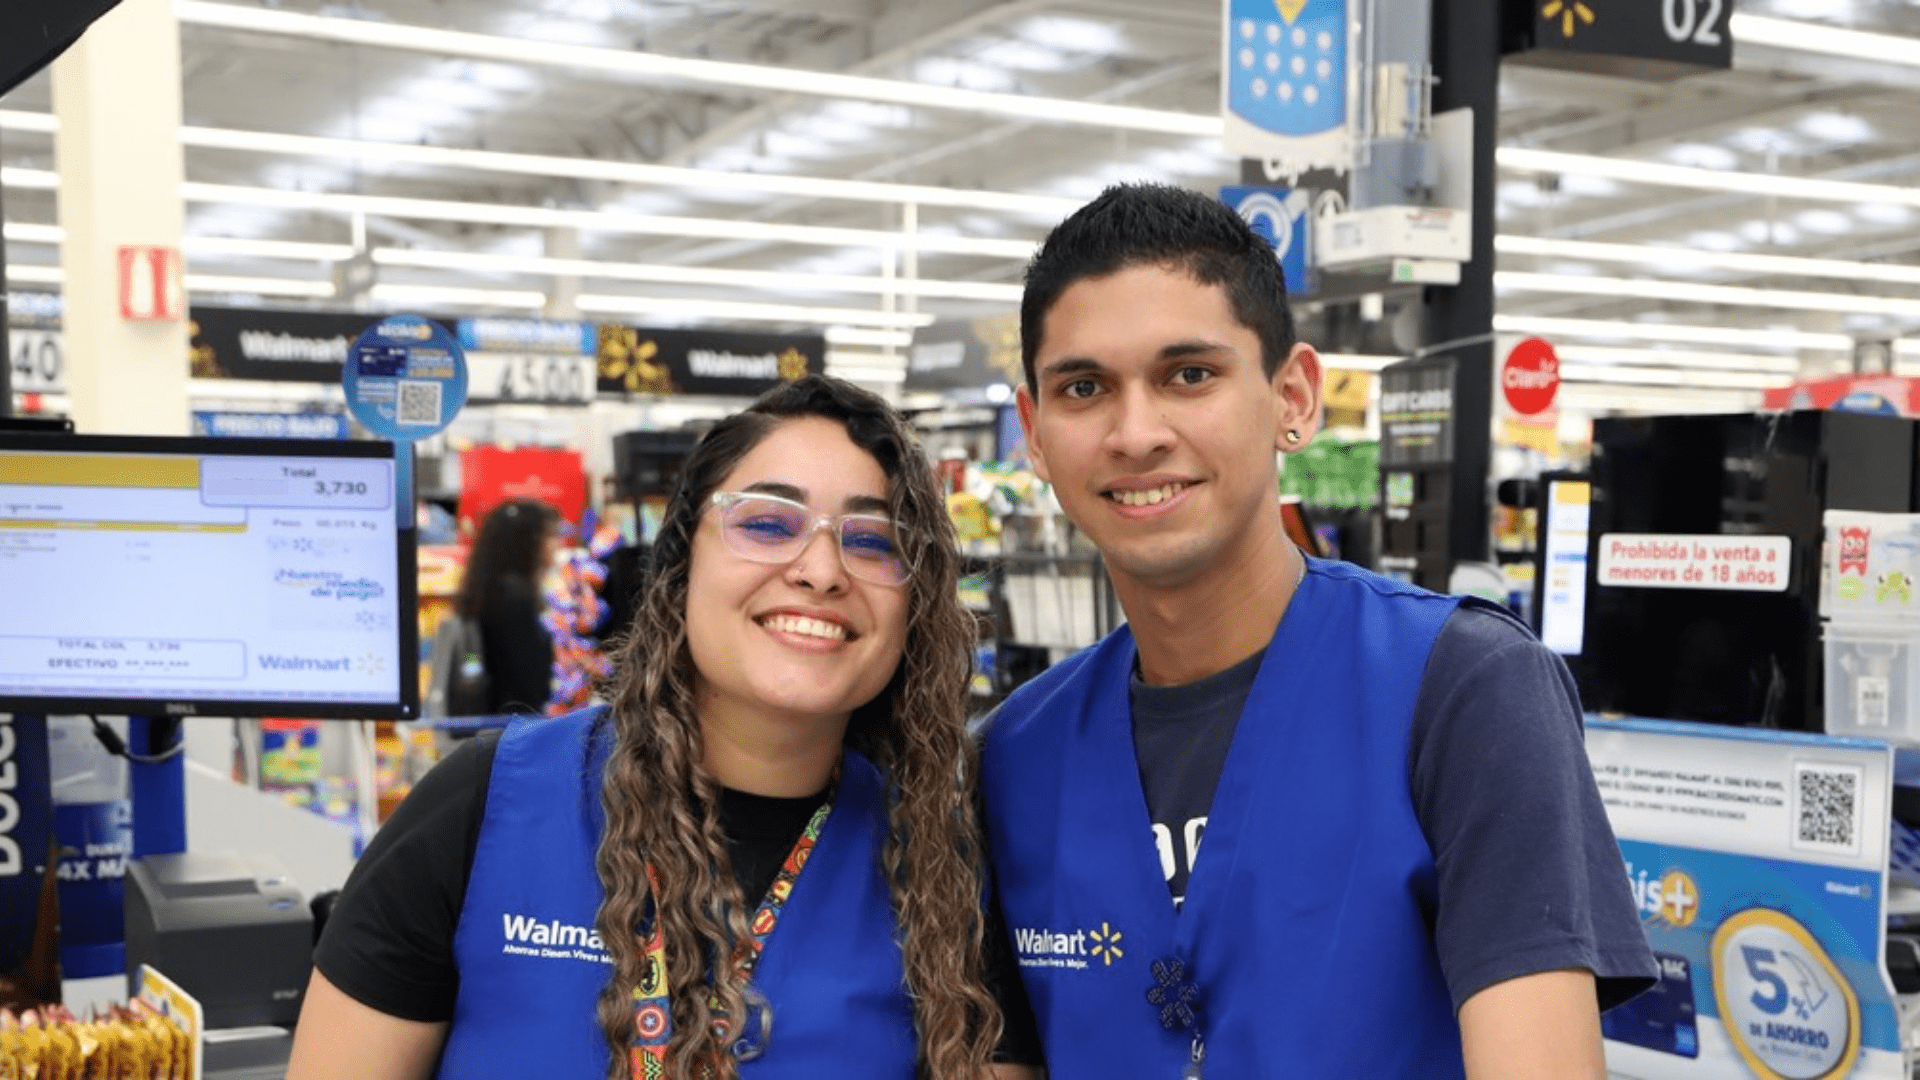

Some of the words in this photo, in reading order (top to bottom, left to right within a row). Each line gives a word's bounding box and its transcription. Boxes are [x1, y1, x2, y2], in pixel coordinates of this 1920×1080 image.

[1662, 0, 1721, 45] 02
[239, 330, 347, 362] Walmart
[688, 350, 779, 379] Walmart
[282, 466, 317, 477] Total
[315, 481, 367, 497] 3,730
[1611, 540, 1689, 560] Prohibida
[1694, 541, 1707, 560] la
[1713, 545, 1761, 562] venta
[1766, 548, 1777, 562] a
[1609, 566, 1677, 581] menores
[1682, 565, 1703, 582] de
[1711, 564, 1730, 582] 18
[1735, 564, 1776, 584] años
[257, 655, 350, 672] Walmart
[1765, 1021, 1830, 1050] AHORRO
